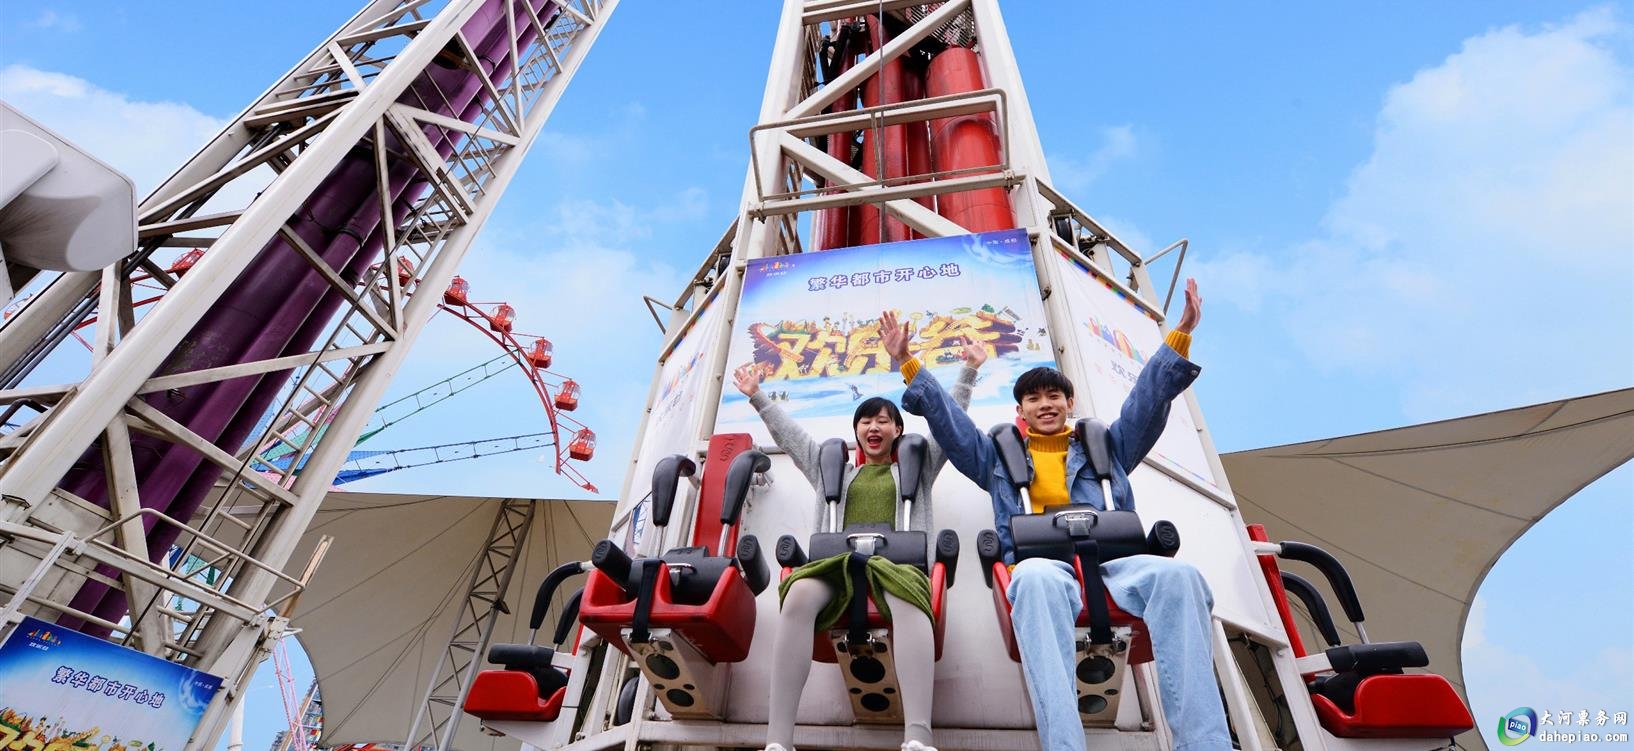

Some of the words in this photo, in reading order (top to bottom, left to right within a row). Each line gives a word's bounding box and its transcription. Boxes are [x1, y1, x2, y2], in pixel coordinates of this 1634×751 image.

[808, 262, 961, 292] 繁华都市开心地
[52, 665, 166, 709] 繁华都市开心地
